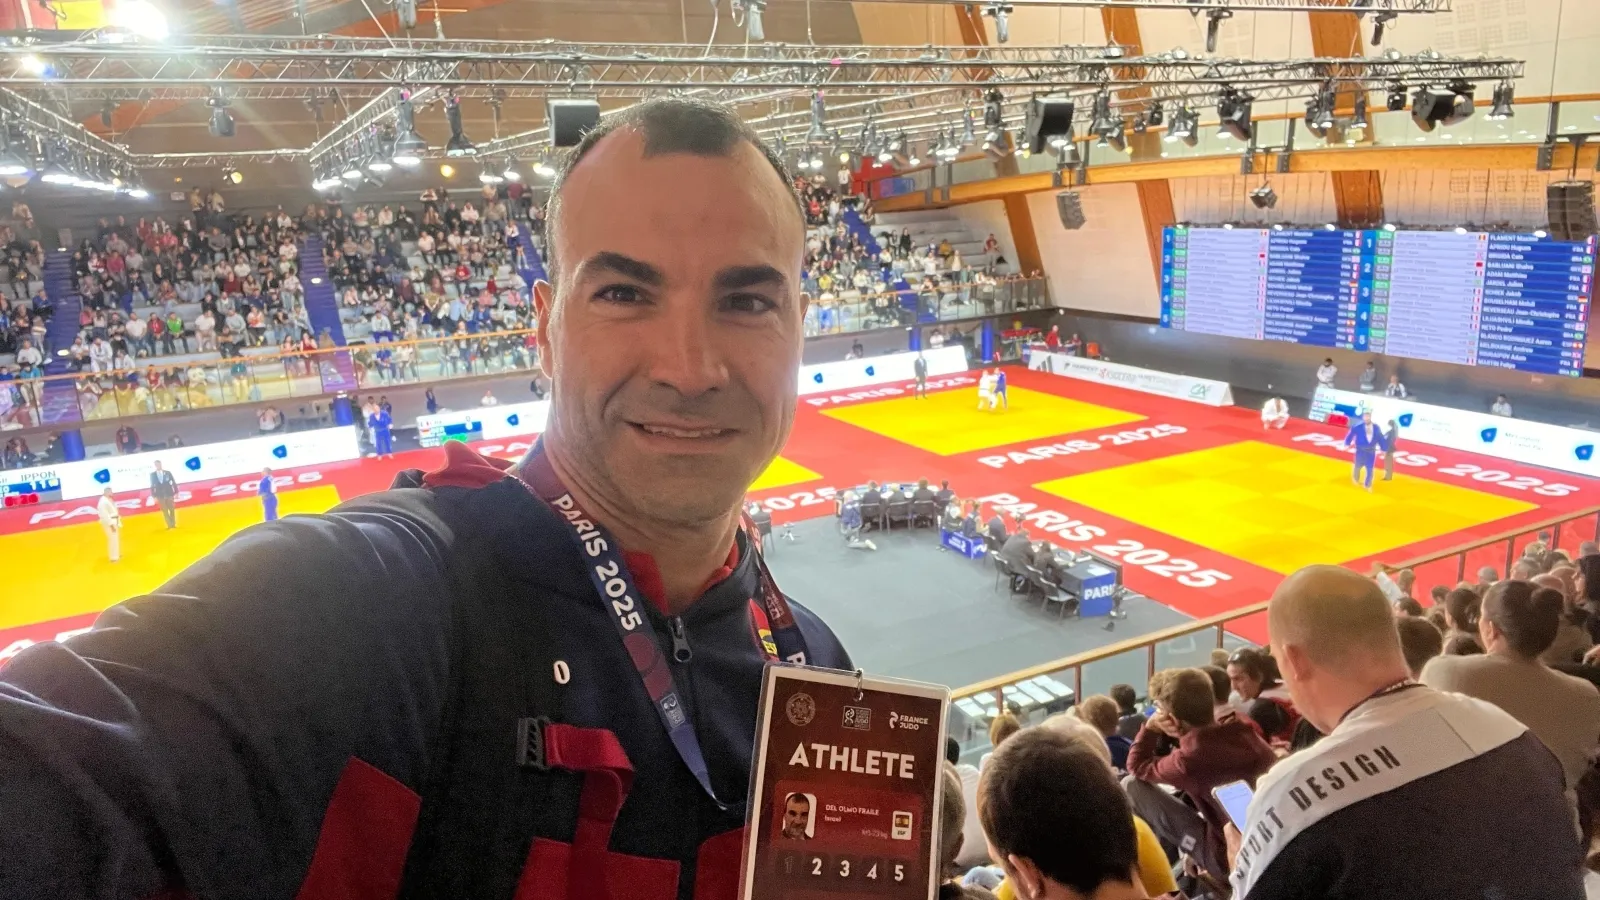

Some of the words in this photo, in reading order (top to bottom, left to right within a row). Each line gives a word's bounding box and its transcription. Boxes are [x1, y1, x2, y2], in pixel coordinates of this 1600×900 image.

[1366, 238, 1372, 248] 1
[1364, 263, 1371, 272] 2
[1362, 287, 1369, 297] 3
[1360, 311, 1367, 321] 4
[805, 387, 905, 407] PARIS
[977, 438, 1100, 469] PARIS
[1098, 423, 1188, 447] 2025
[20, 470, 57, 482] IPPON
[1438, 463, 1580, 497] 2025
[977, 492, 1107, 543] PARIS
[1093, 538, 1234, 589] 2025
[551, 493, 608, 558] PARIS
[595, 560, 643, 631] 2025
[899, 714, 929, 725] FRANCE
[899, 722, 920, 731] JUDO
[788, 741, 915, 779] ATHLETE
[1288, 744, 1401, 811] DESIGN
[825, 804, 837, 812] DEL
[838, 805, 857, 814] OLMO
[858, 807, 880, 816] FRAILE
[824, 815, 842, 823] Israel
[811, 857, 822, 876] 2
[839, 860, 850, 877] 3
[866, 862, 878, 880] 4
[894, 864, 904, 882] 5
